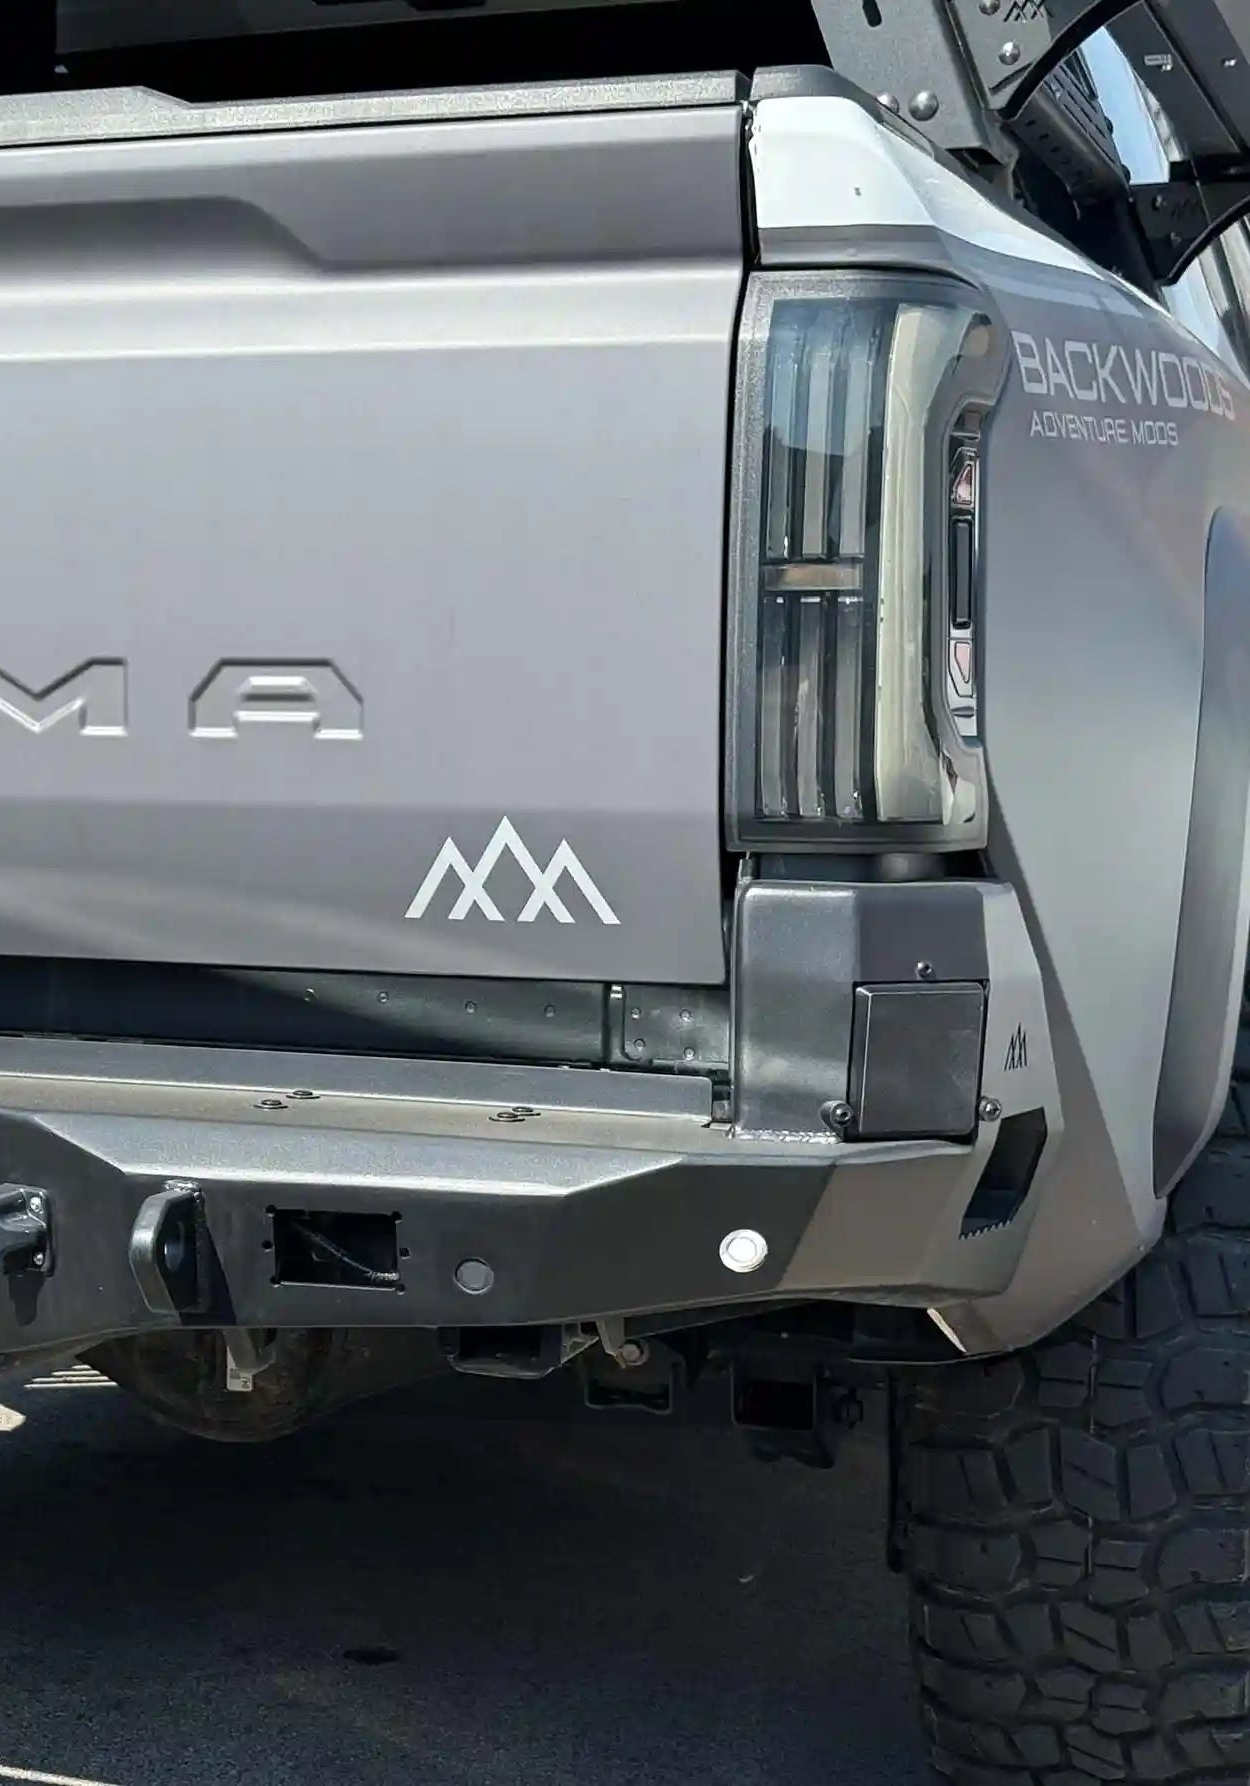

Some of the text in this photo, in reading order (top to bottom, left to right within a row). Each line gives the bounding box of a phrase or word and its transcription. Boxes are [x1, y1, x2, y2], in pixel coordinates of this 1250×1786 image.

[1011, 330, 1236, 421] BACKWOODS
[1030, 410, 1179, 446] ADVENTURE MODS
